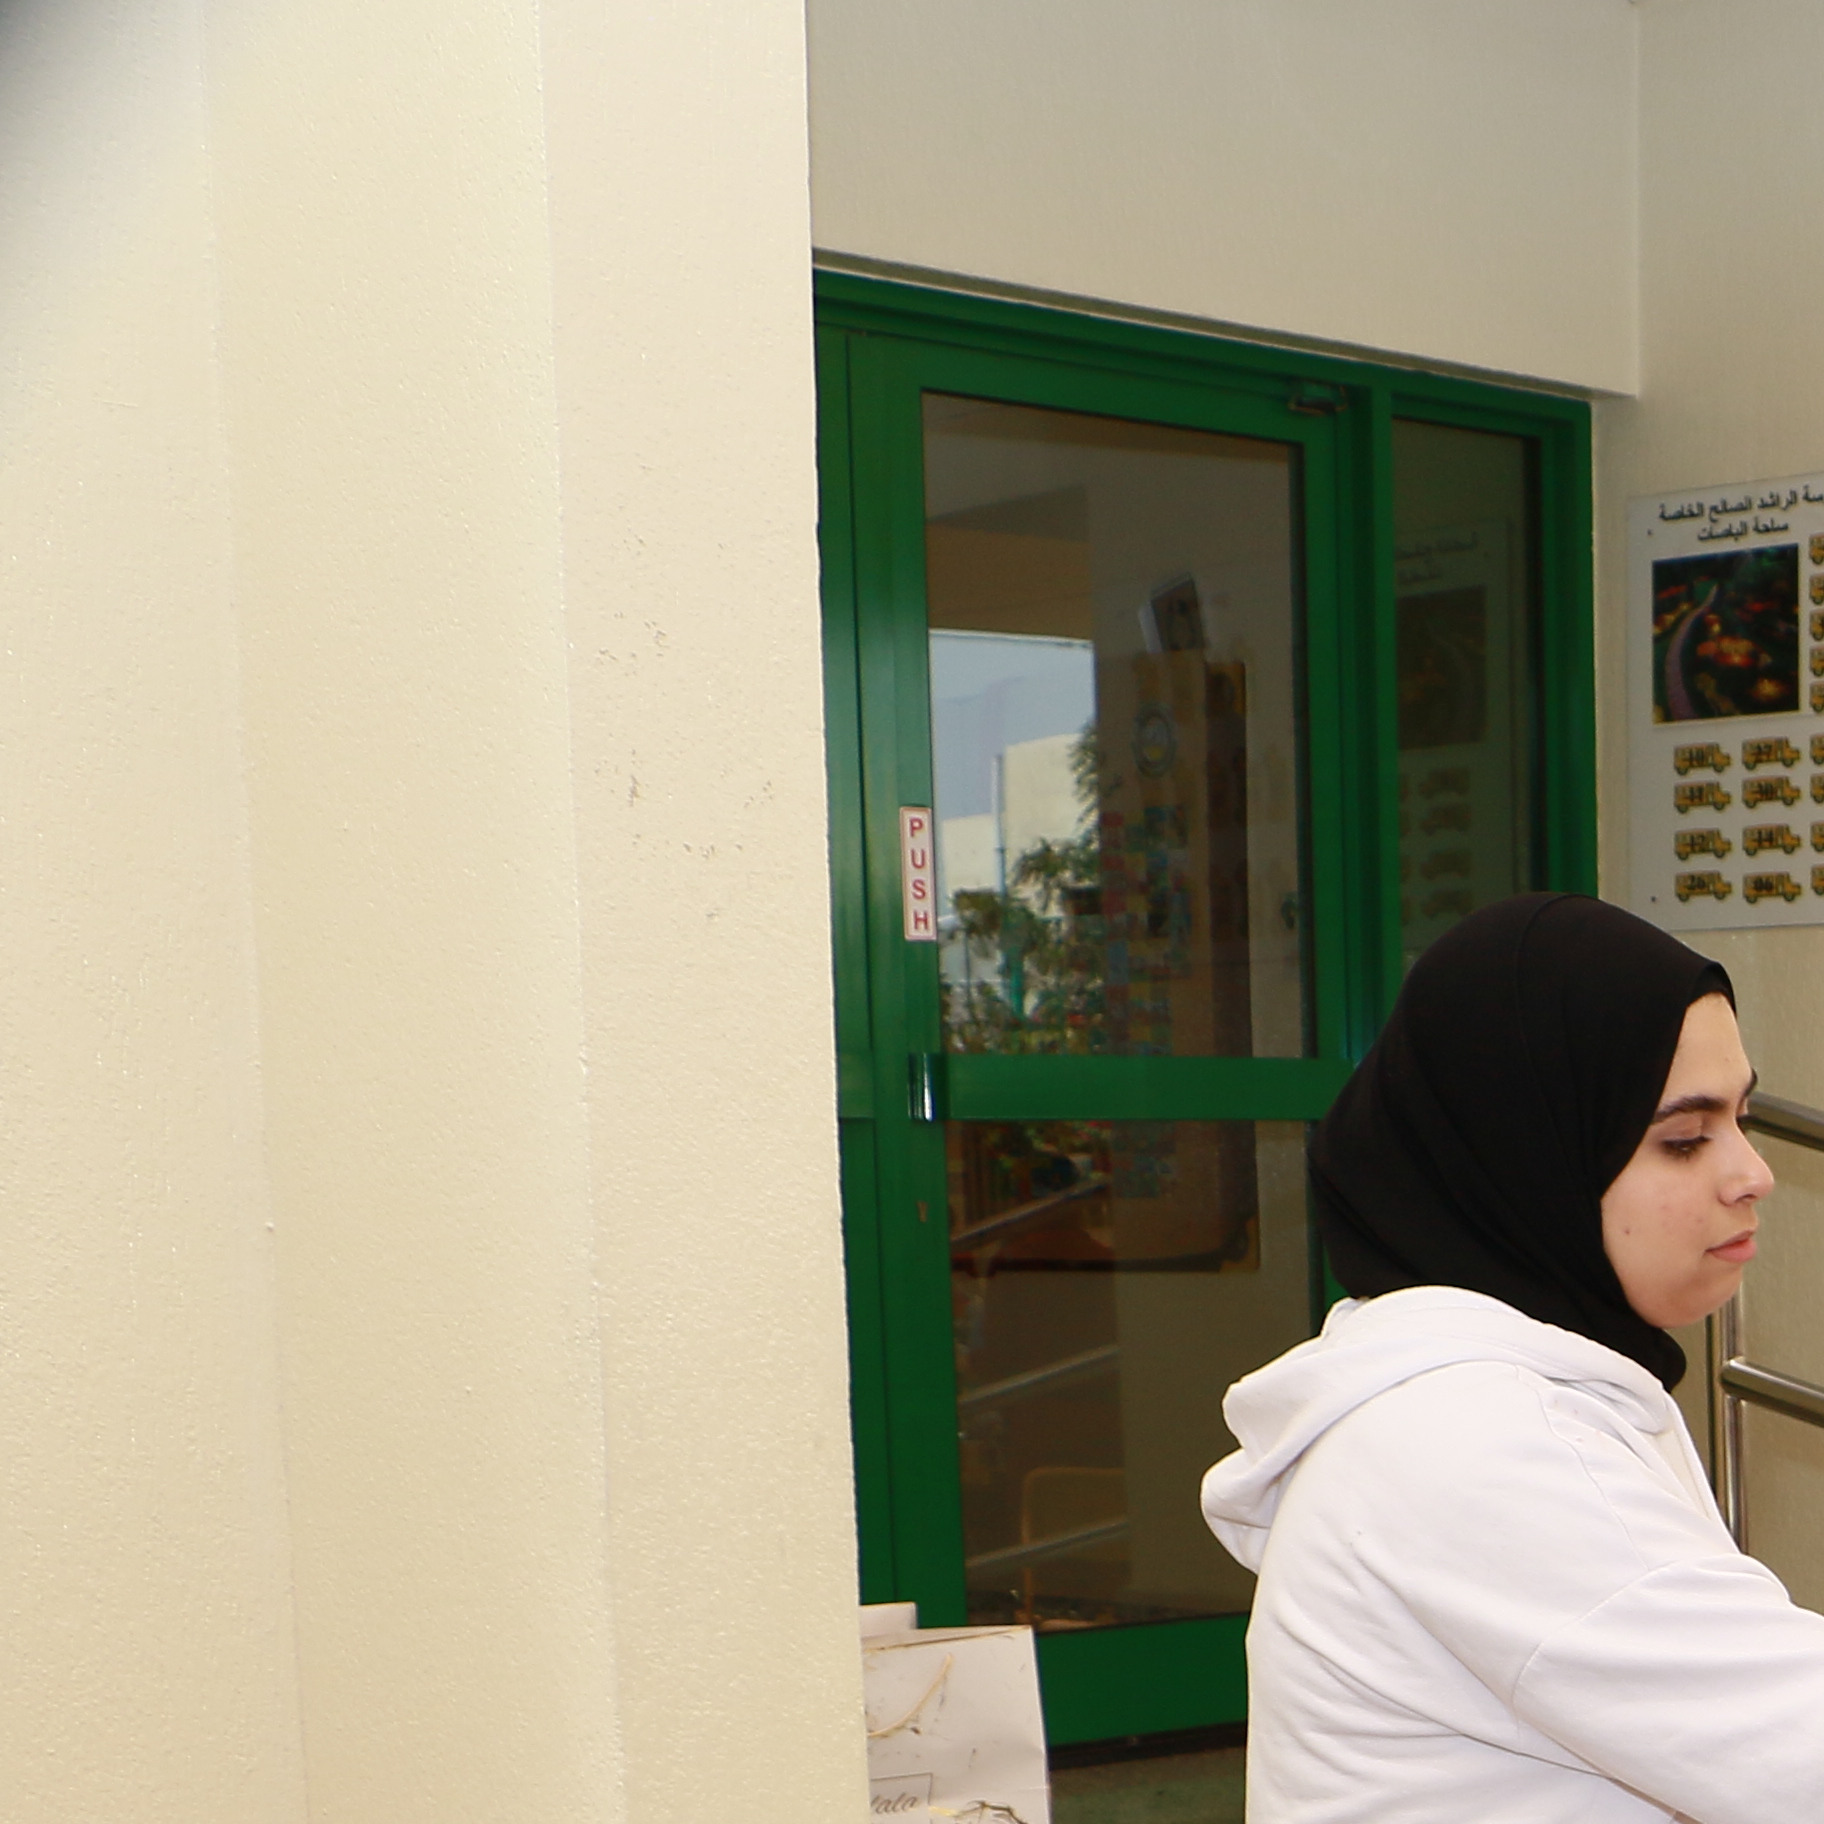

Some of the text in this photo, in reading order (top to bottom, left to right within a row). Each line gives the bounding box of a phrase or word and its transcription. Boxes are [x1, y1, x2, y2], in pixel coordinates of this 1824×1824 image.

[1659, 502, 1704, 521] الخاصة
[1708, 496, 1753, 523] الصالح
[909, 816, 929, 931] PUSH
